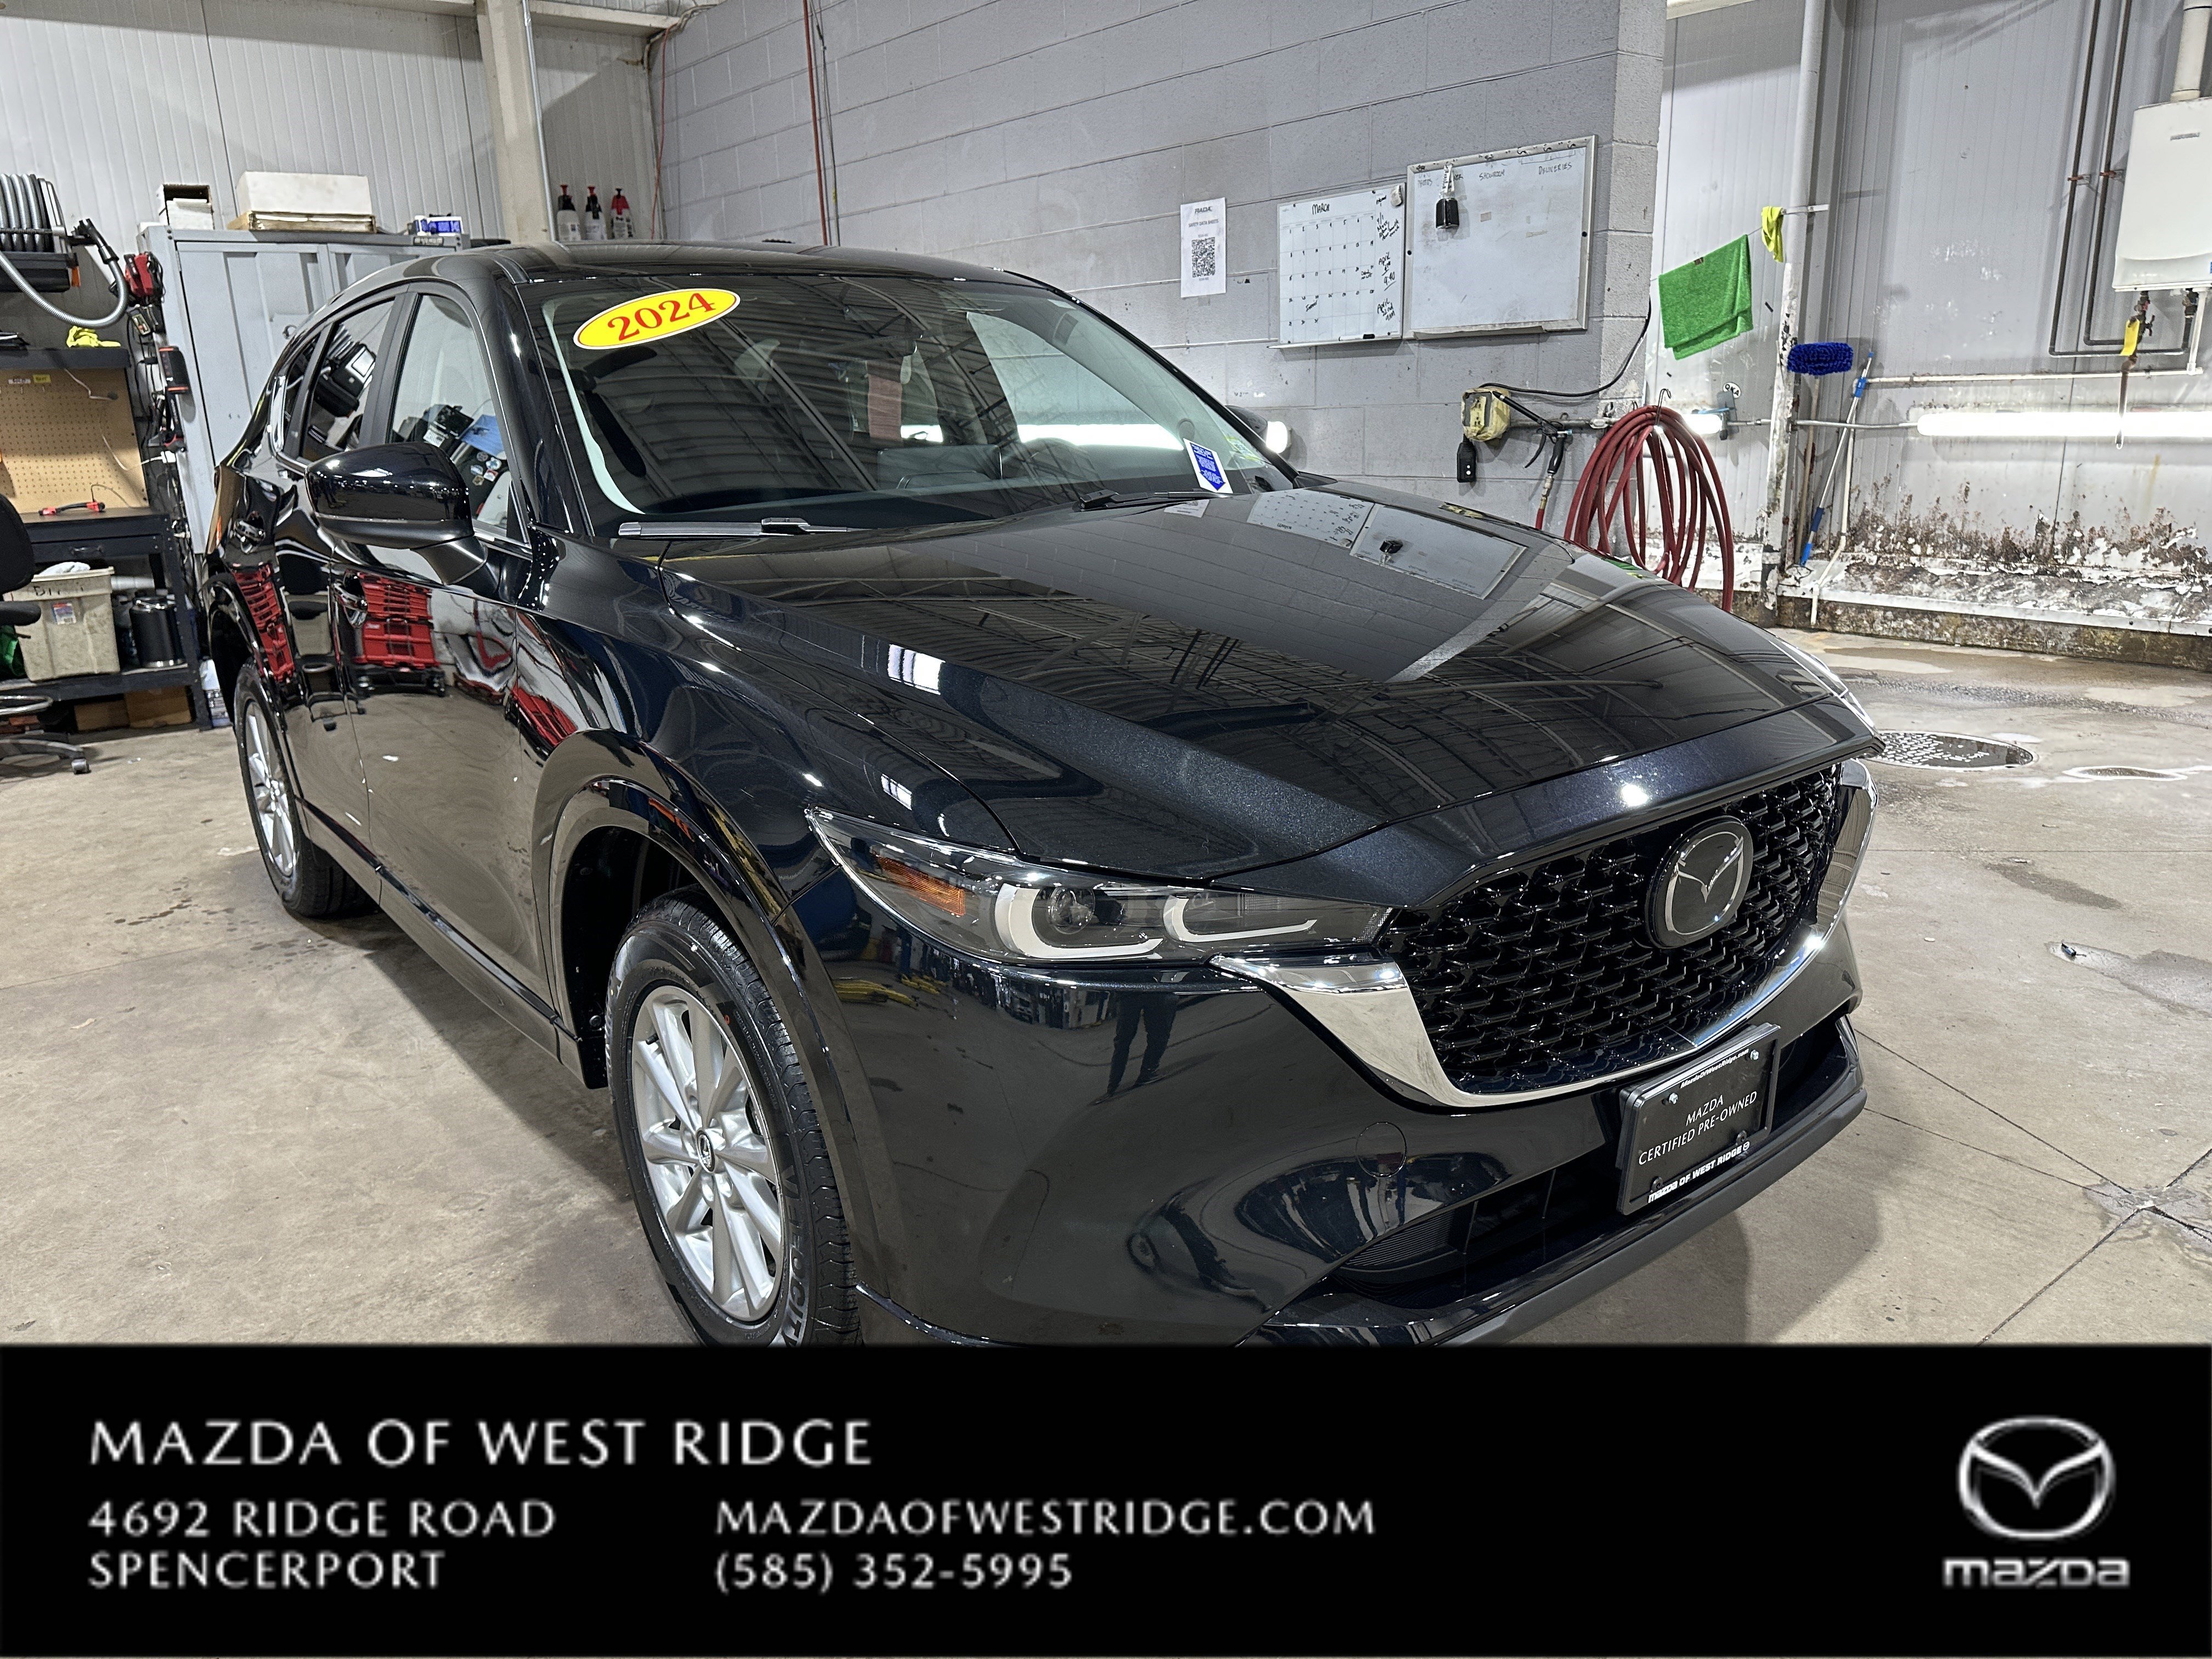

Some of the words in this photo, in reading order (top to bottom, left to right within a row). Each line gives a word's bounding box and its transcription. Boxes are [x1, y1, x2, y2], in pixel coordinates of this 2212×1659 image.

[1312, 203, 1330, 215] MARCH
[607, 292, 716, 341] 2024
[1638, 1128, 1696, 1166] CERTIFIED
[1698, 1091, 1758, 1136] PRE-OWNED
[1686, 1094, 1724, 1126] MAZDA
[1679, 1173, 1691, 1187] OF
[1692, 1161, 1717, 1180] WEST
[1717, 1144, 1742, 1167] RIDGE
